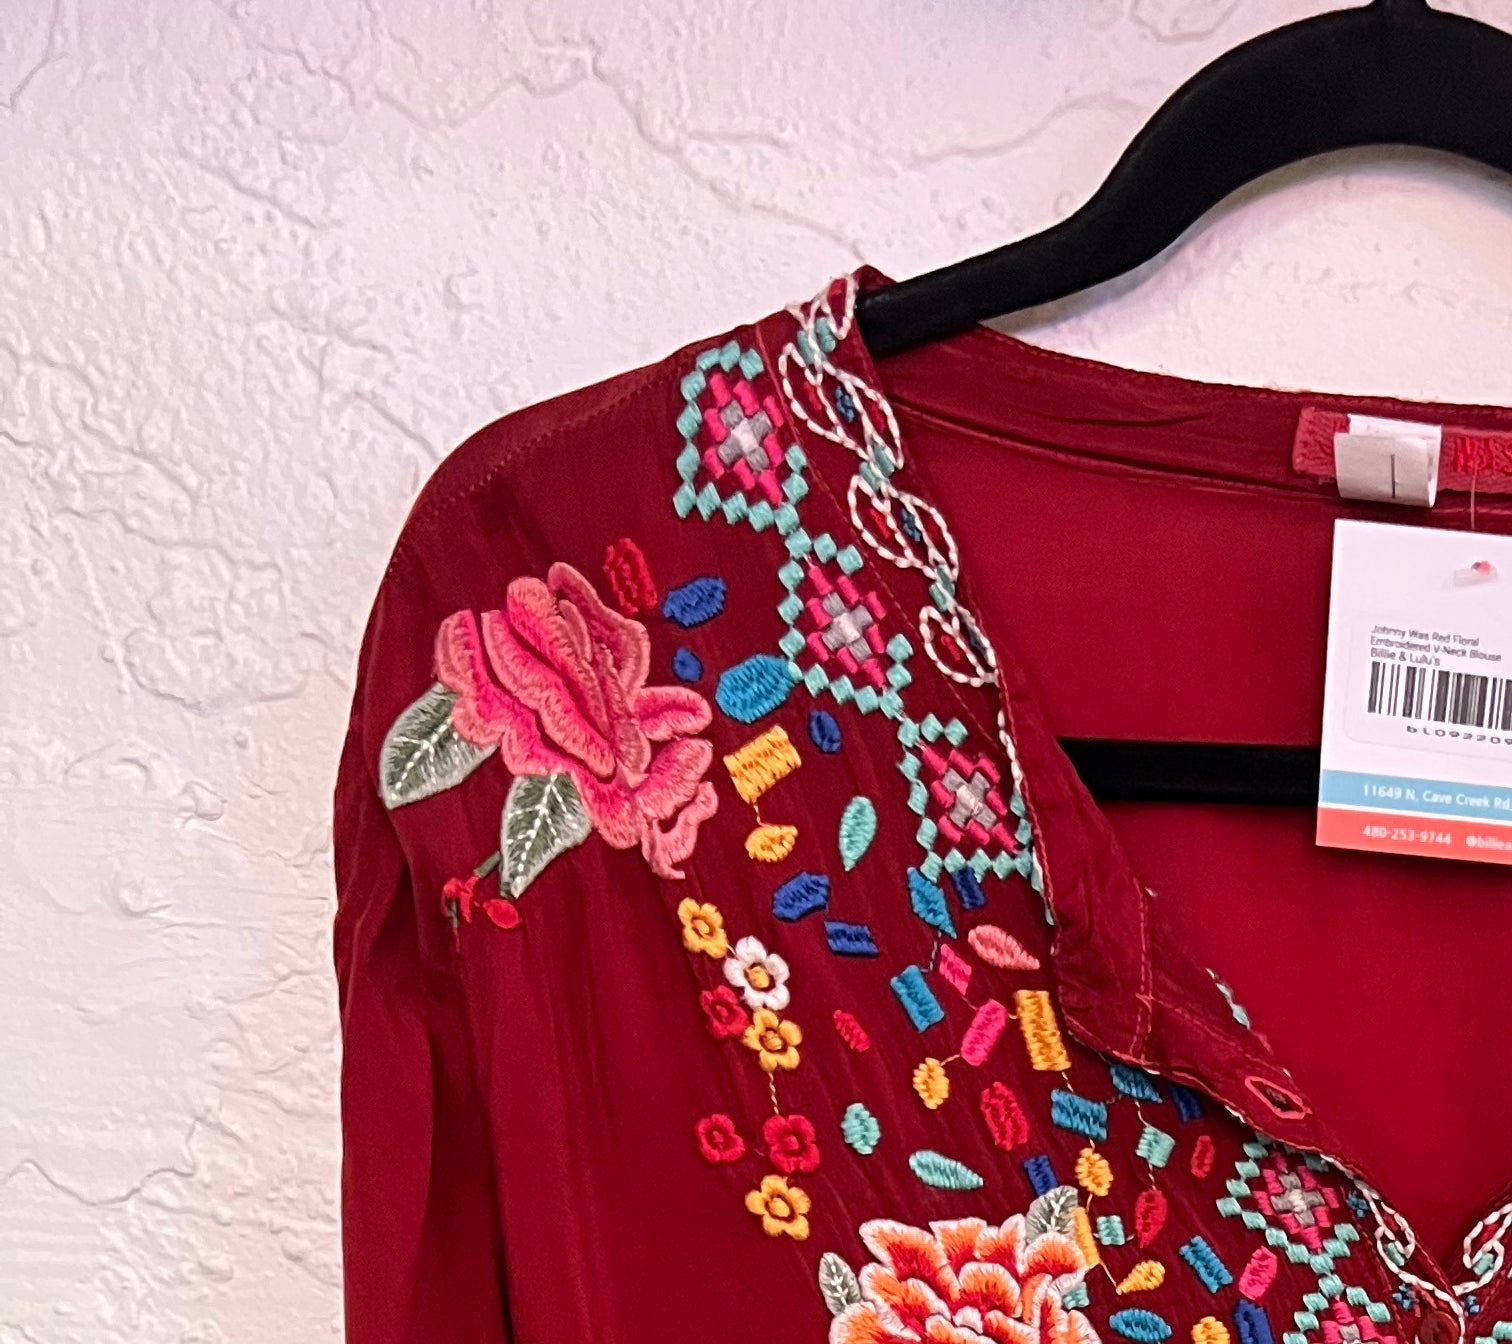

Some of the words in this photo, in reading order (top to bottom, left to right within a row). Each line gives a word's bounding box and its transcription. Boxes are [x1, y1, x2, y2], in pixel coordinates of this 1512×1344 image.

[1371, 625, 1406, 639] Johnny
[1409, 629, 1429, 641] Was
[1432, 632, 1451, 643] Red
[1453, 634, 1480, 647] Floral
[1370, 635, 1431, 653] Embroidered
[1433, 644, 1467, 657] V-Neck
[1469, 649, 1501, 662] Blouse
[1370, 648, 1396, 661] Billie
[1399, 651, 1407, 662] &
[1409, 653, 1441, 667] Lulu's
[1363, 784, 1401, 800] 11649
[1422, 791, 1452, 805] Cave
[1456, 793, 1490, 808] Creek
[1362, 824, 1452, 846] 480-253-9744
